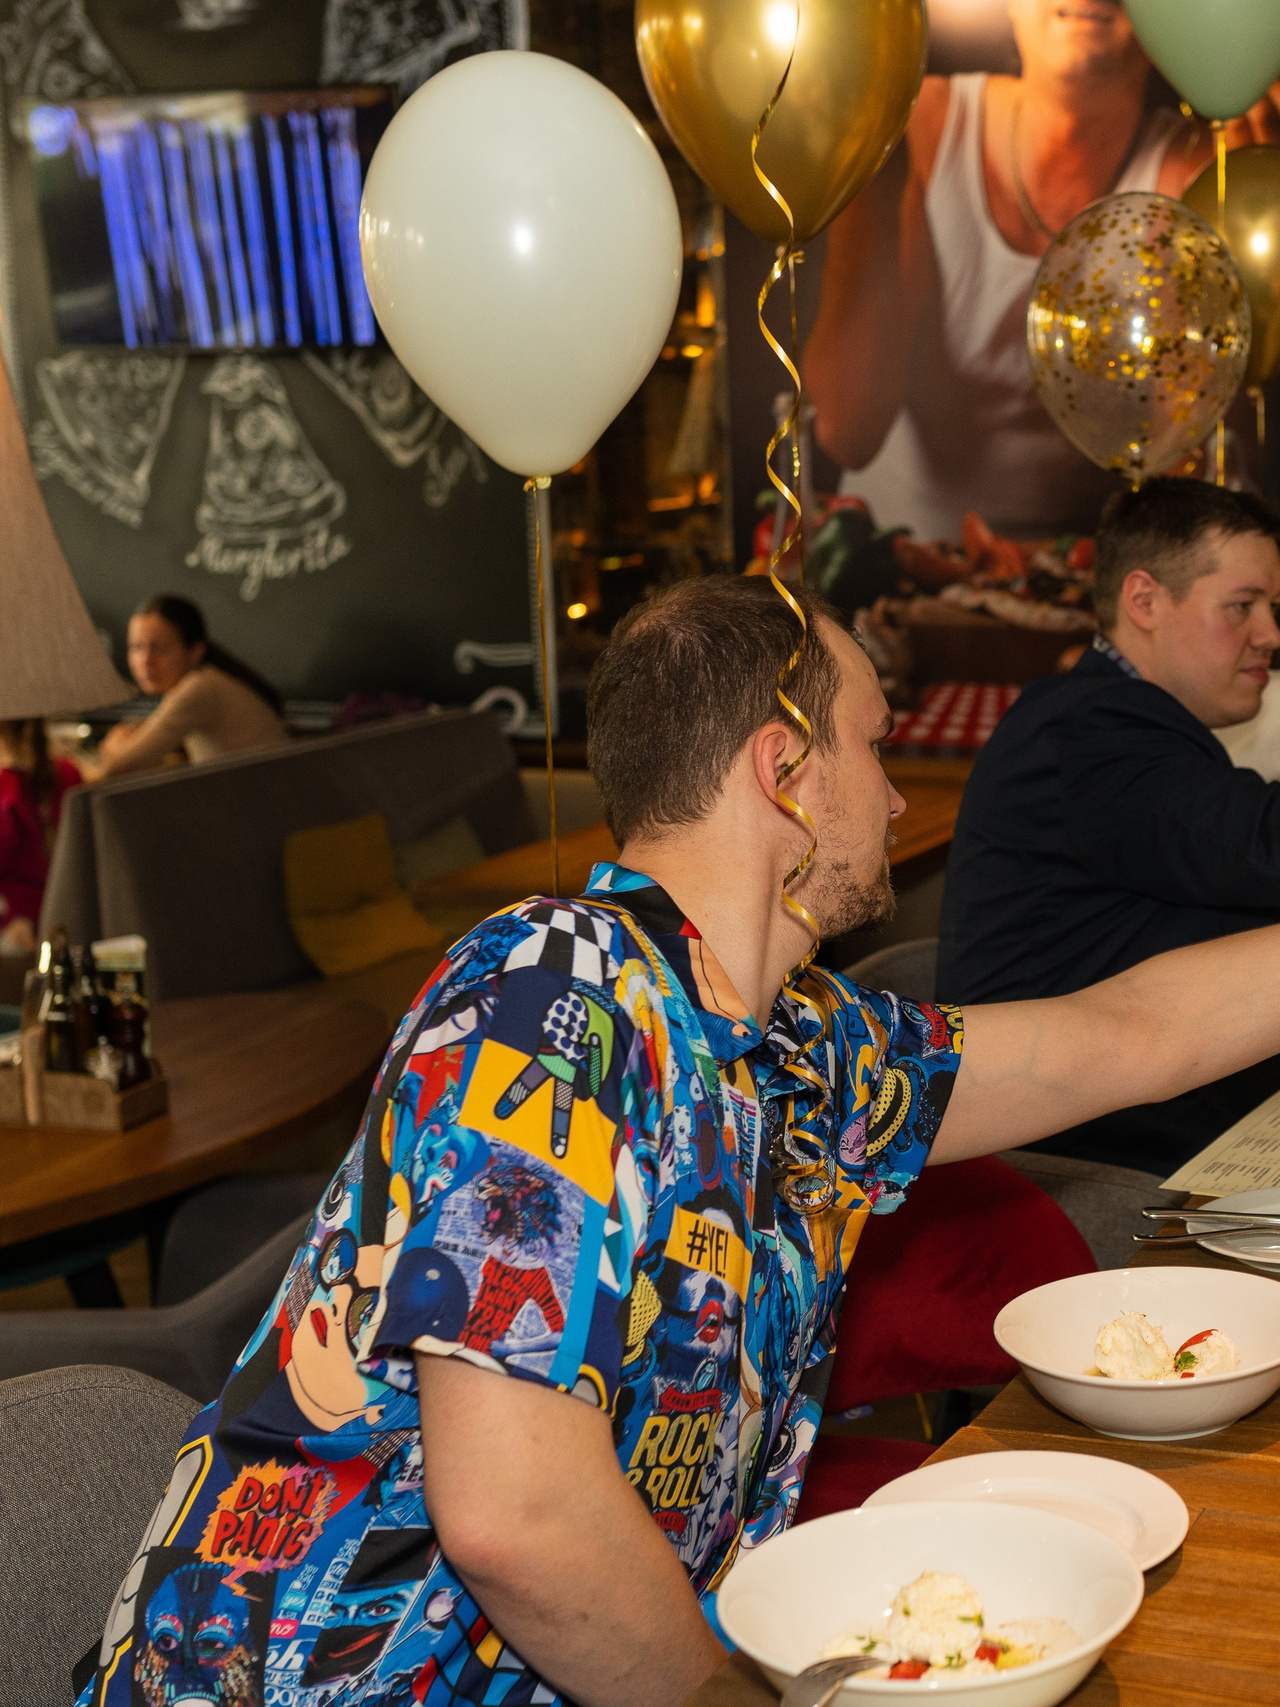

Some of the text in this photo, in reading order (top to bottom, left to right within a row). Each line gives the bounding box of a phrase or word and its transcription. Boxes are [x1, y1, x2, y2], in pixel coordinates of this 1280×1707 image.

[685, 1219, 729, 1279] #YE!
[628, 1411, 726, 1469] ROCK
[645, 1465, 706, 1508] ROLL
